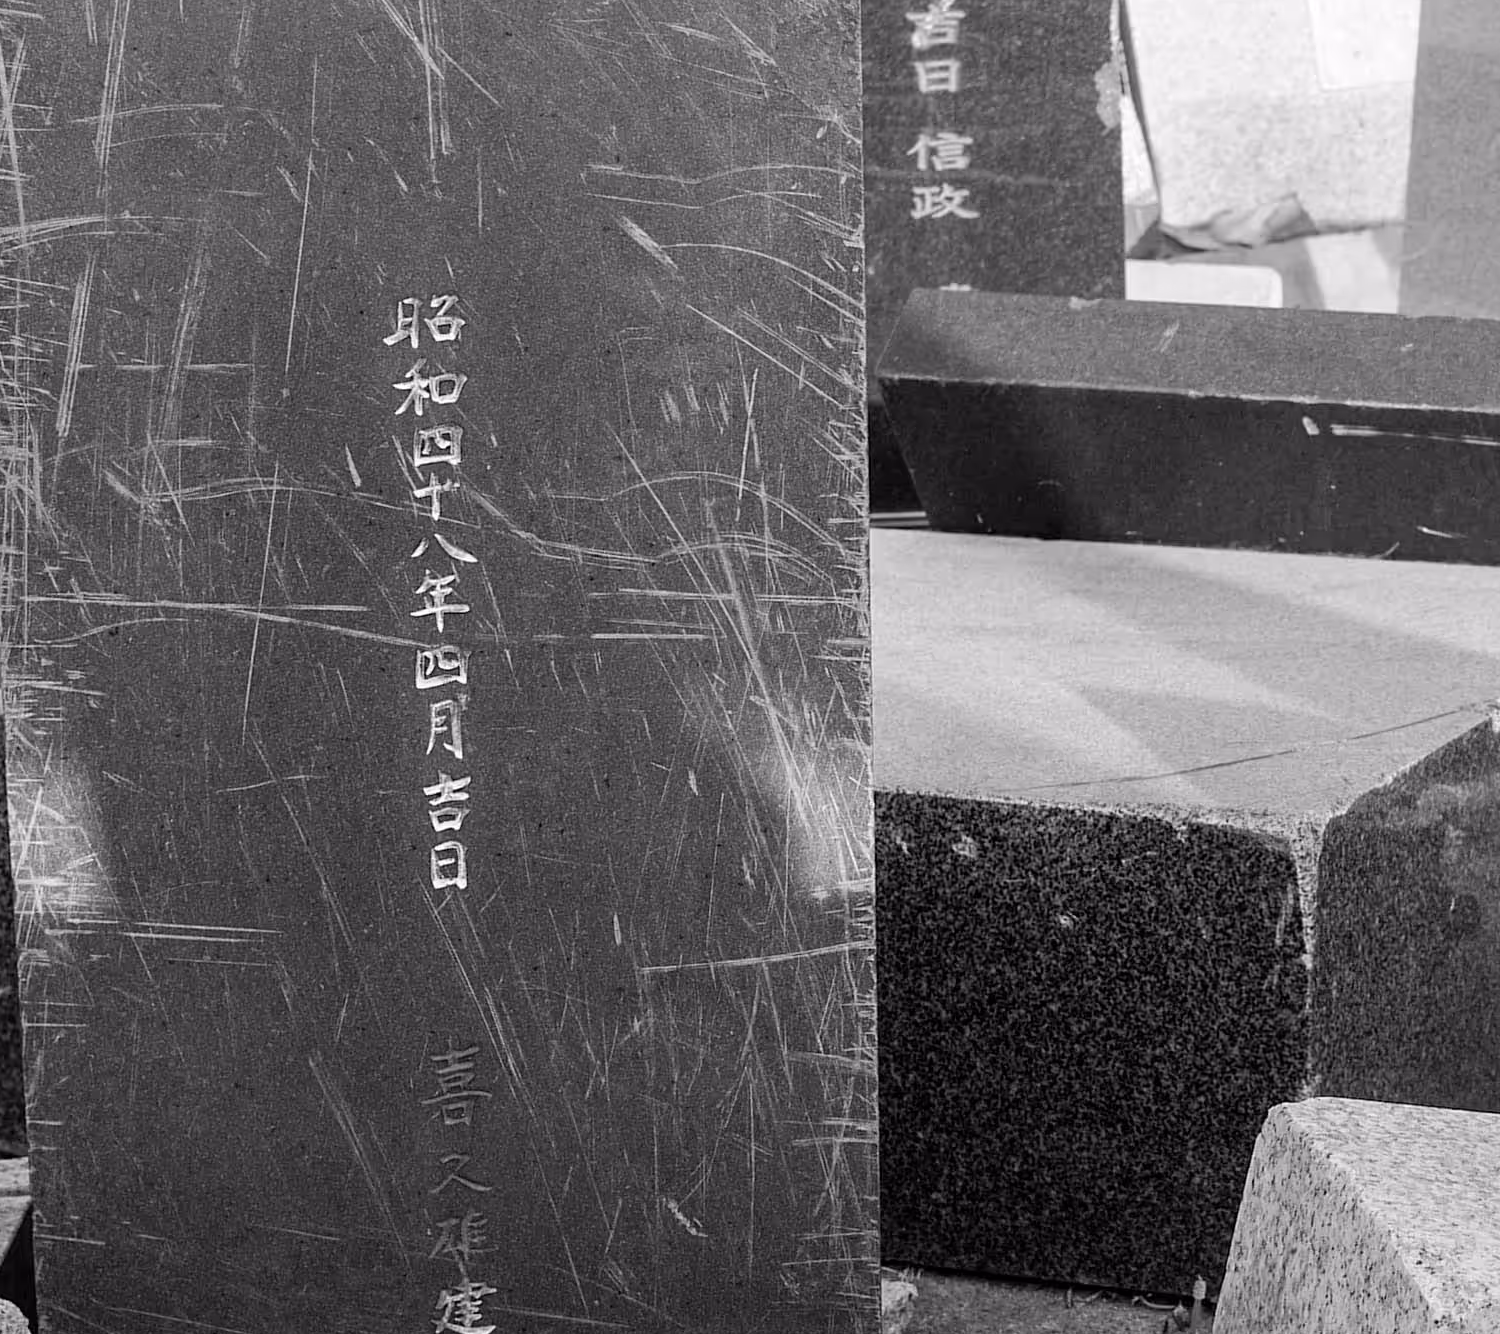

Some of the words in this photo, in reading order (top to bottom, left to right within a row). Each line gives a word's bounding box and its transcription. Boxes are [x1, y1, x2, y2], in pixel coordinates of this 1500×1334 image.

[382, 292, 478, 891] 昭和四十八年四月吉日
